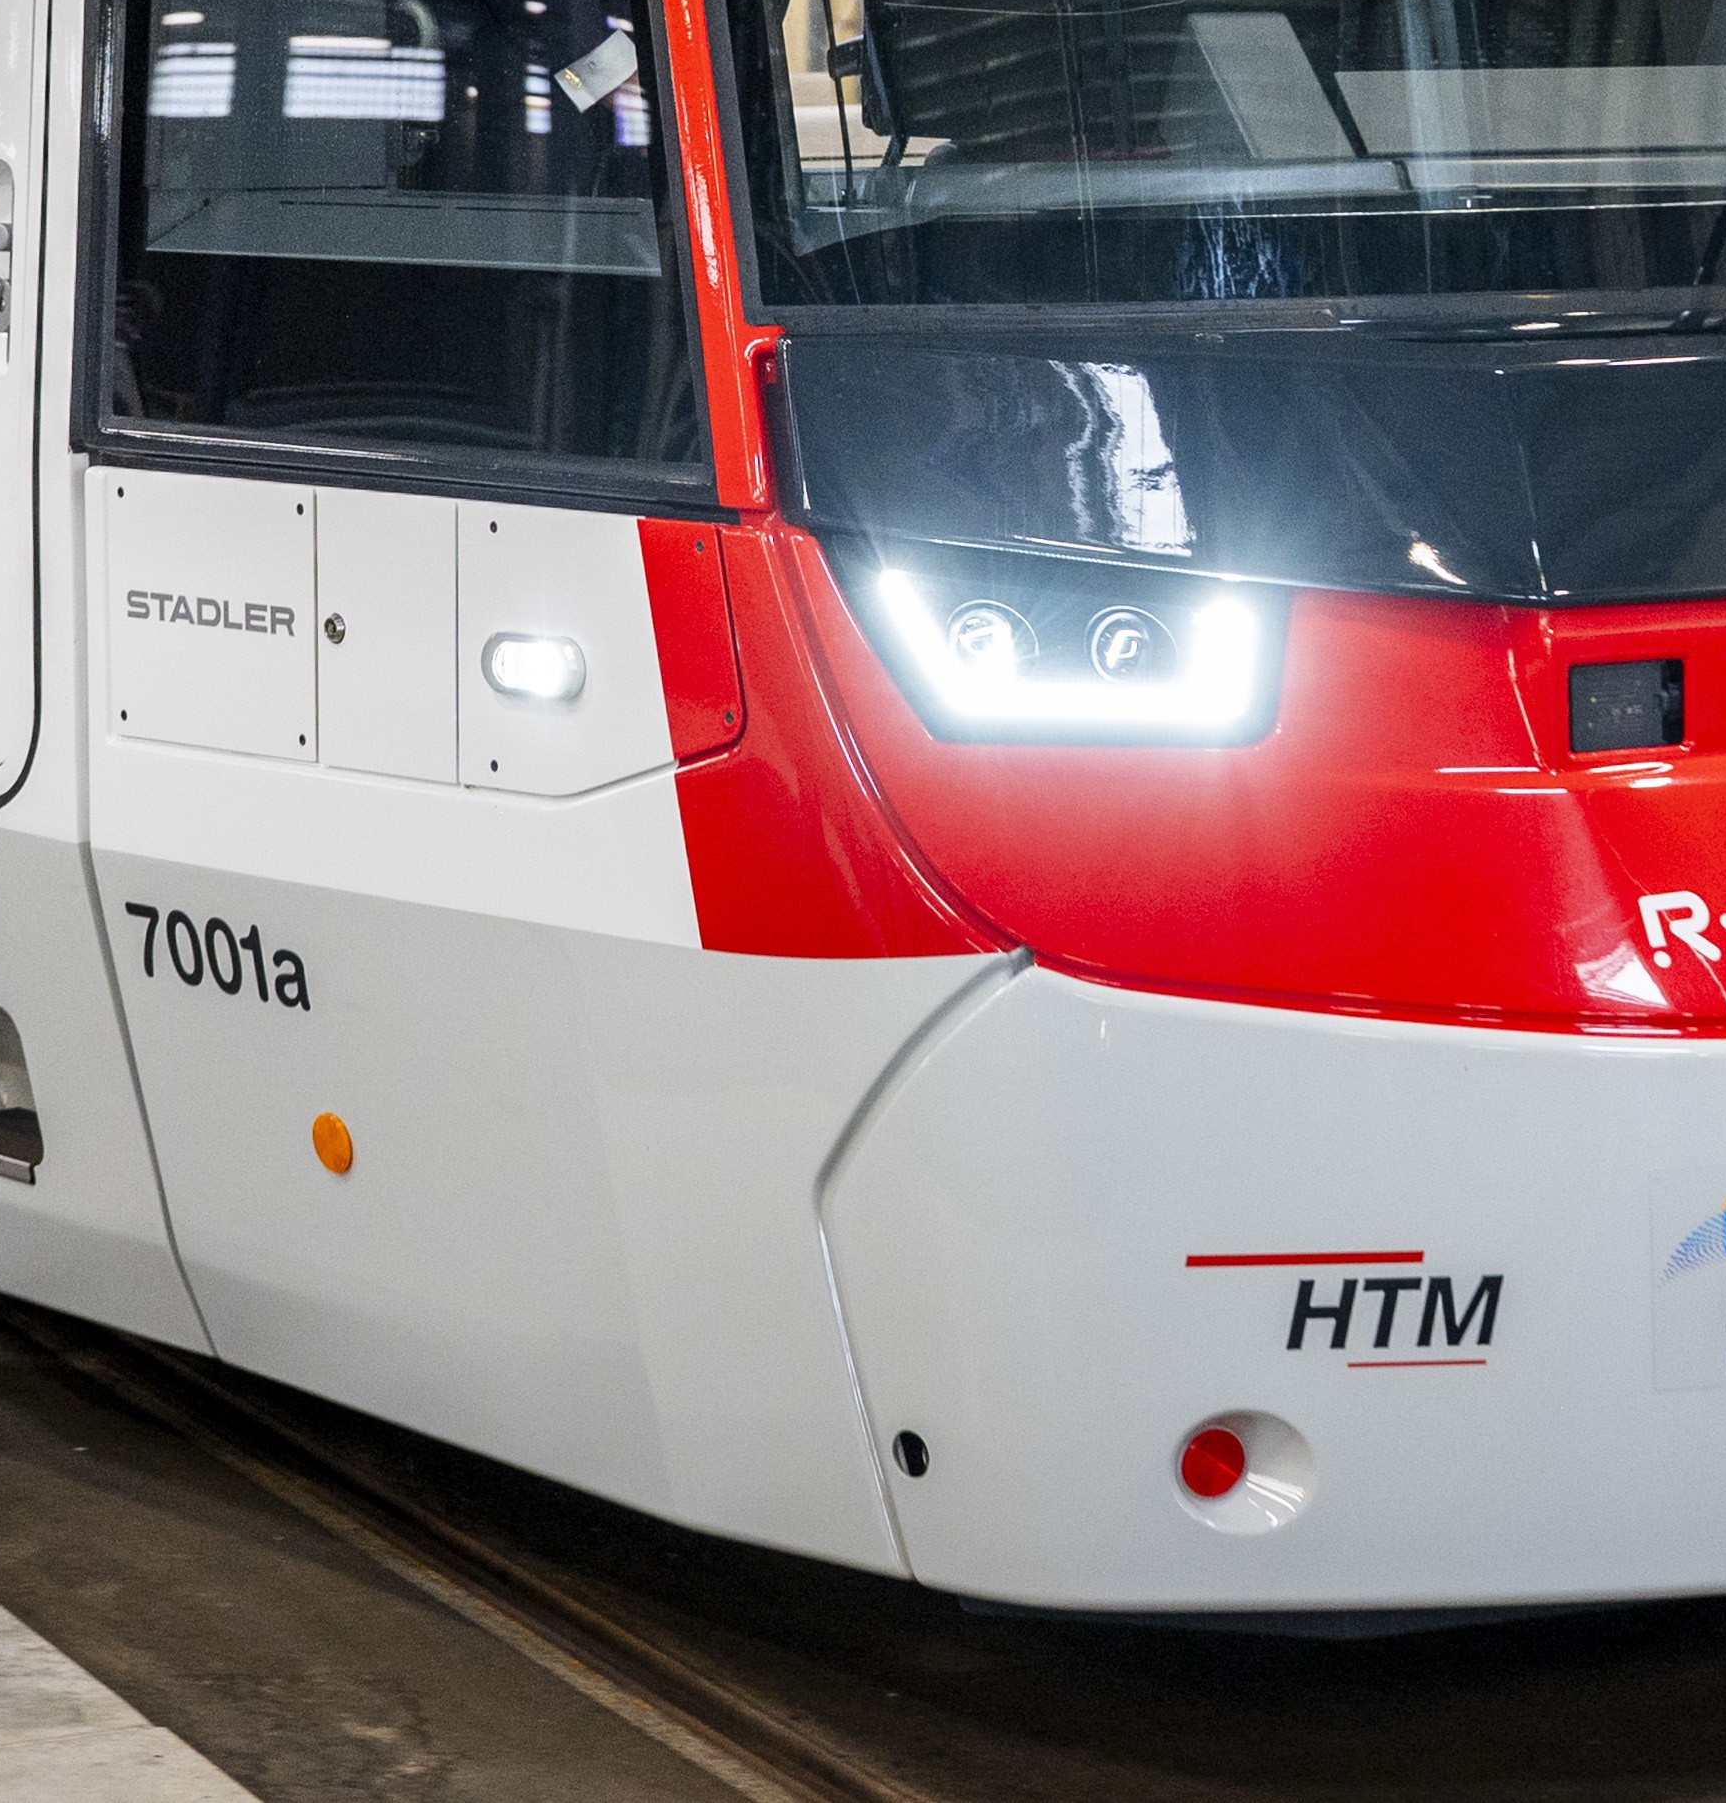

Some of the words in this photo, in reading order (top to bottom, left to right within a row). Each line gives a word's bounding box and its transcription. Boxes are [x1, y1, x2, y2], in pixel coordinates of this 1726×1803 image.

[126, 589, 295, 638] STADLER
[125, 901, 311, 1012] 7001a
[1286, 1274, 1504, 1351] HTM
